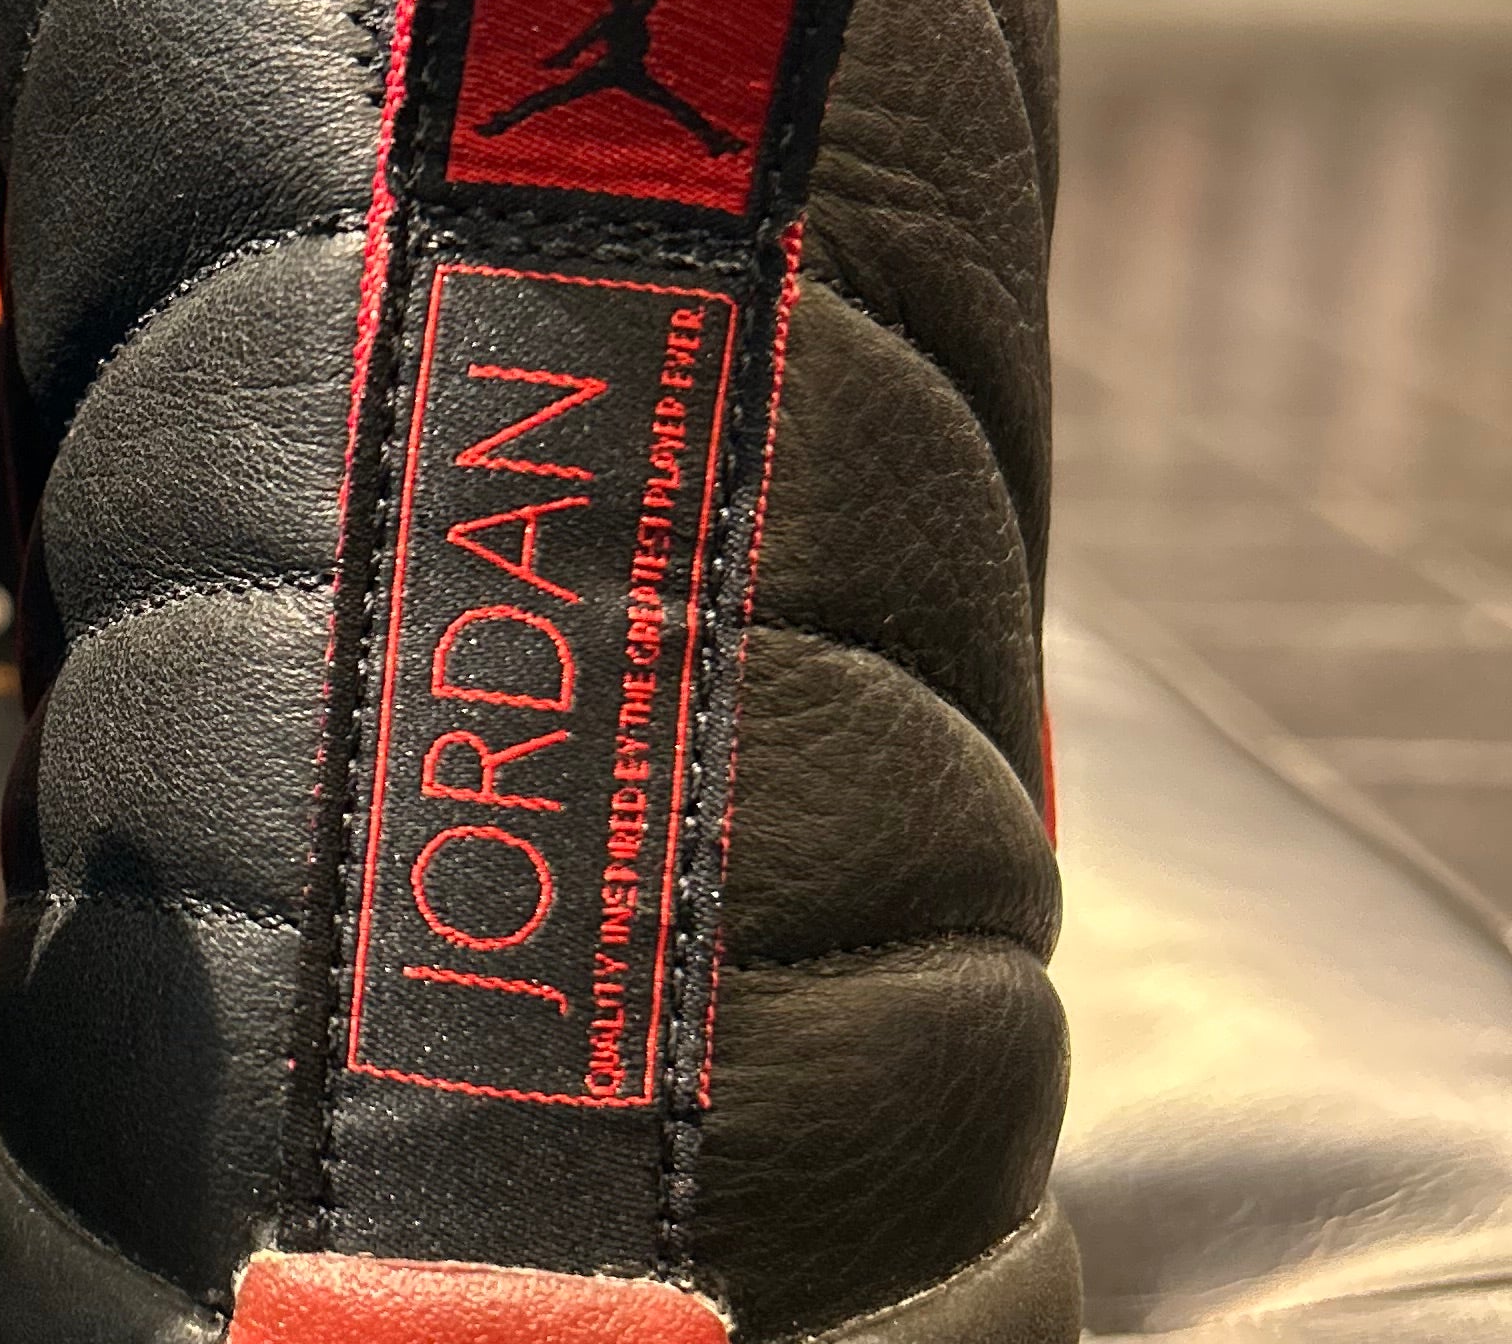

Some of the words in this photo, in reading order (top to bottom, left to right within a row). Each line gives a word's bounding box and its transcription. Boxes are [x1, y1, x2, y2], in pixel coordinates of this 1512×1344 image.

[641, 395, 686, 508] PLAYER
[624, 515, 672, 665] GREATEST
[403, 363, 608, 1016] JORDAN
[618, 671, 656, 733] THE
[599, 786, 647, 944] INSPIRED
[585, 951, 629, 1095] QUALITY
